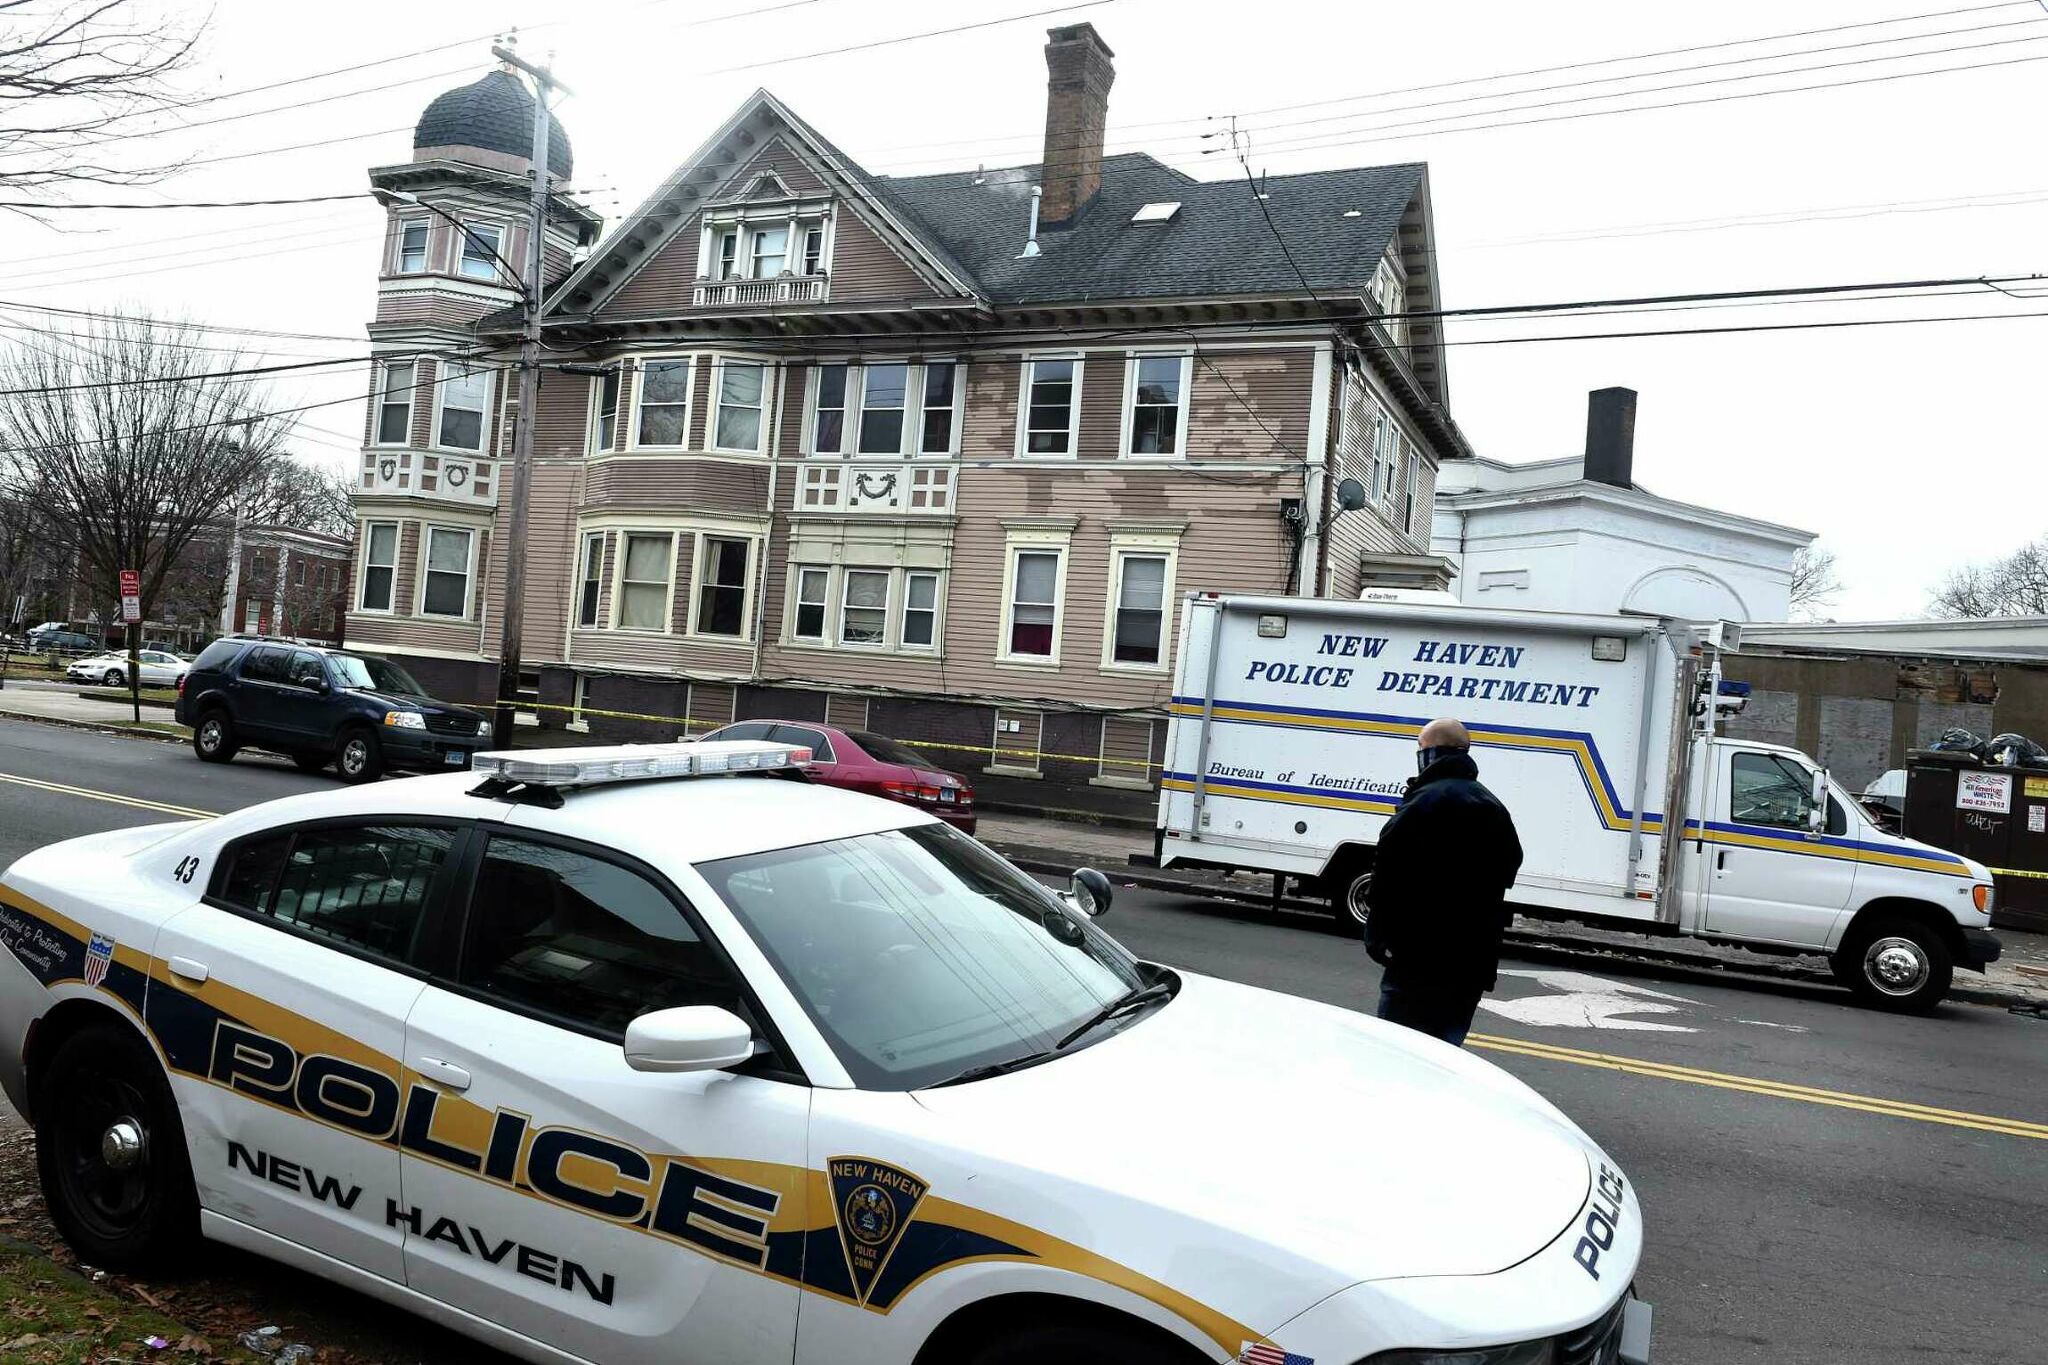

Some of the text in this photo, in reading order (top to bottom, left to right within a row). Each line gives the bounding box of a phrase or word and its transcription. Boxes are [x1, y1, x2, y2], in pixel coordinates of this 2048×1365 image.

[1317, 634, 1525, 668] NEW HAVEN
[1245, 661, 1600, 707] POLICE DEPARTMENT
[1208, 762, 1409, 795] Bureau of Identificatio
[174, 855, 200, 884] 43
[33, 929, 68, 962] Protecting
[208, 1018, 783, 1272] POLICE
[833, 1163, 921, 1199] NEW HAVEN
[228, 1141, 615, 1307] NEW HAVEN
[1573, 1162, 1623, 1281] POLICE
[854, 1244, 877, 1260] POLICE
